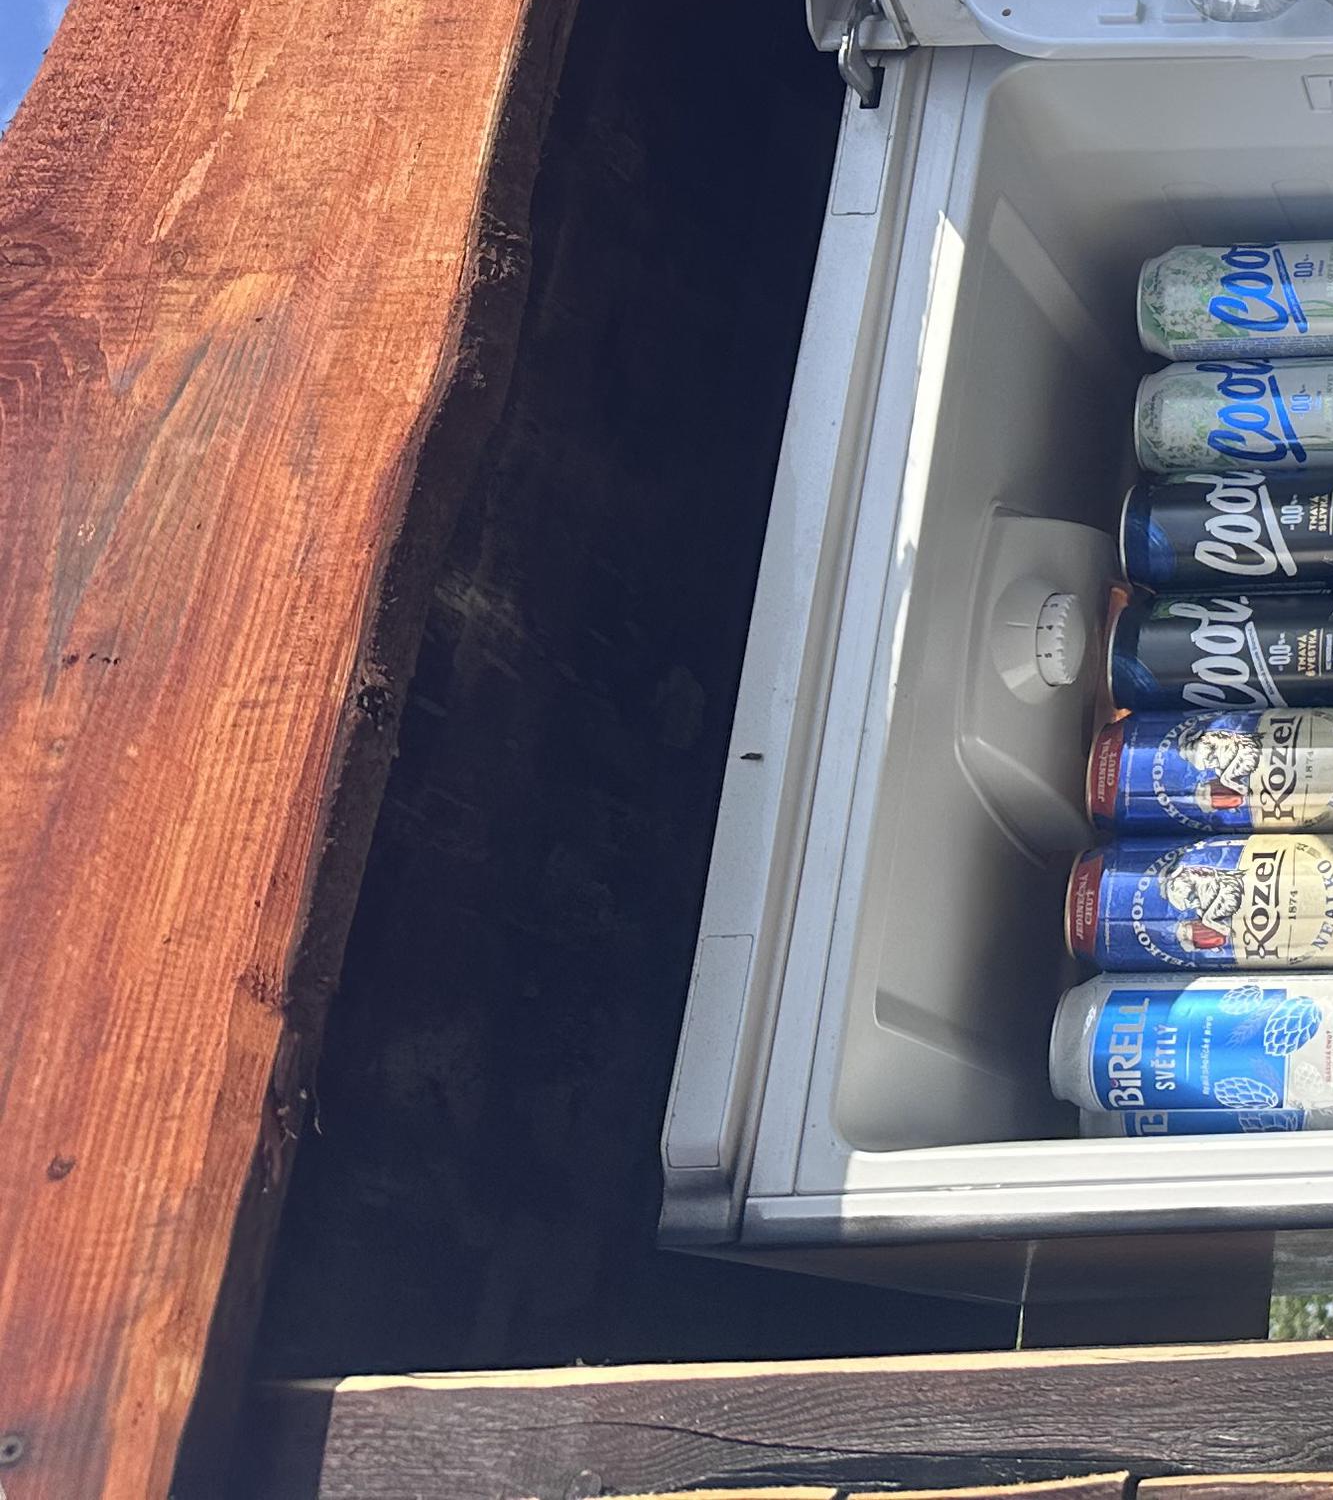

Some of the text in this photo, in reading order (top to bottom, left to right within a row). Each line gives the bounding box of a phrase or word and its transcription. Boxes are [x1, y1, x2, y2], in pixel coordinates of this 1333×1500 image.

[1258, 716, 1297, 820] Kozel
[1304, 750, 1314, 779] 1874
[1242, 850, 1281, 959] Kozel
[1287, 890, 1298, 921] 1874
[1151, 1024, 1177, 1091] SVĚTLÝ
